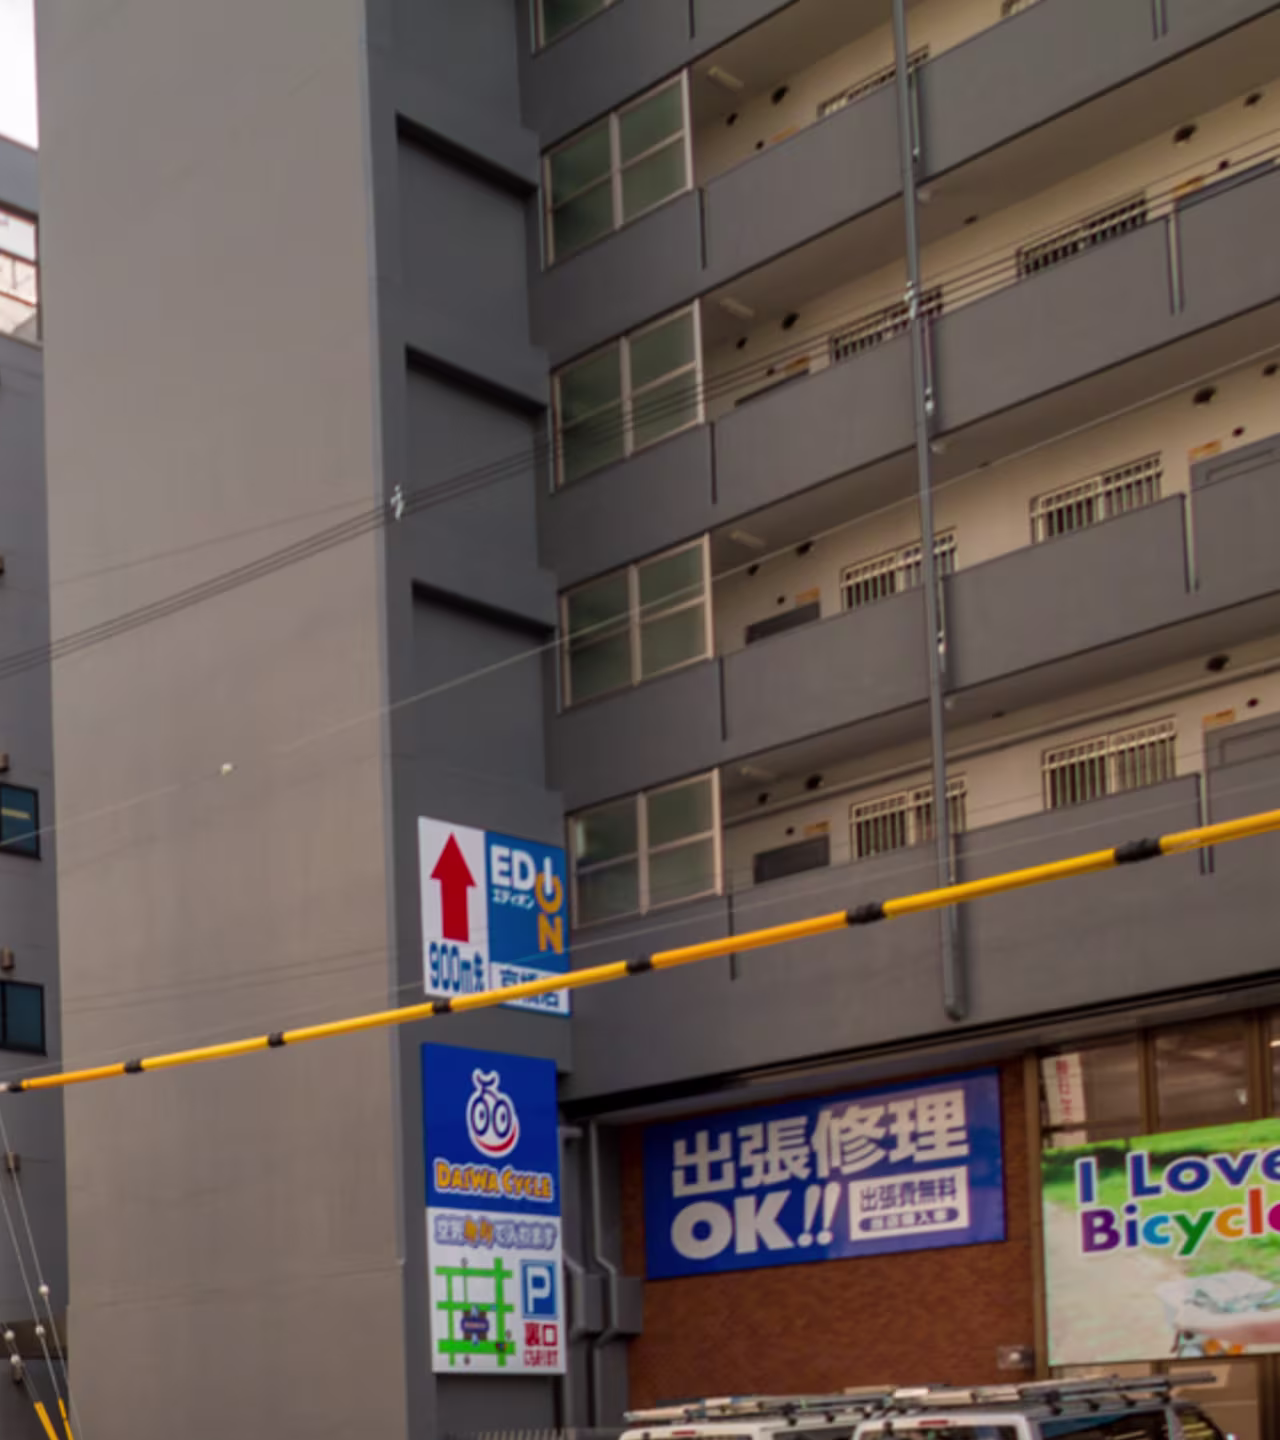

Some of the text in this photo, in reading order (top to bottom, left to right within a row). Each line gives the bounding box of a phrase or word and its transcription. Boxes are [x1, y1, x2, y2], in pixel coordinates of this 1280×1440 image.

[671, 1089, 970, 1198] 出張修理
[436, 1158, 553, 1200] DAIWA CYCLE
[1078, 1160, 1095, 1204] I
[526, 1266, 551, 1314] P
